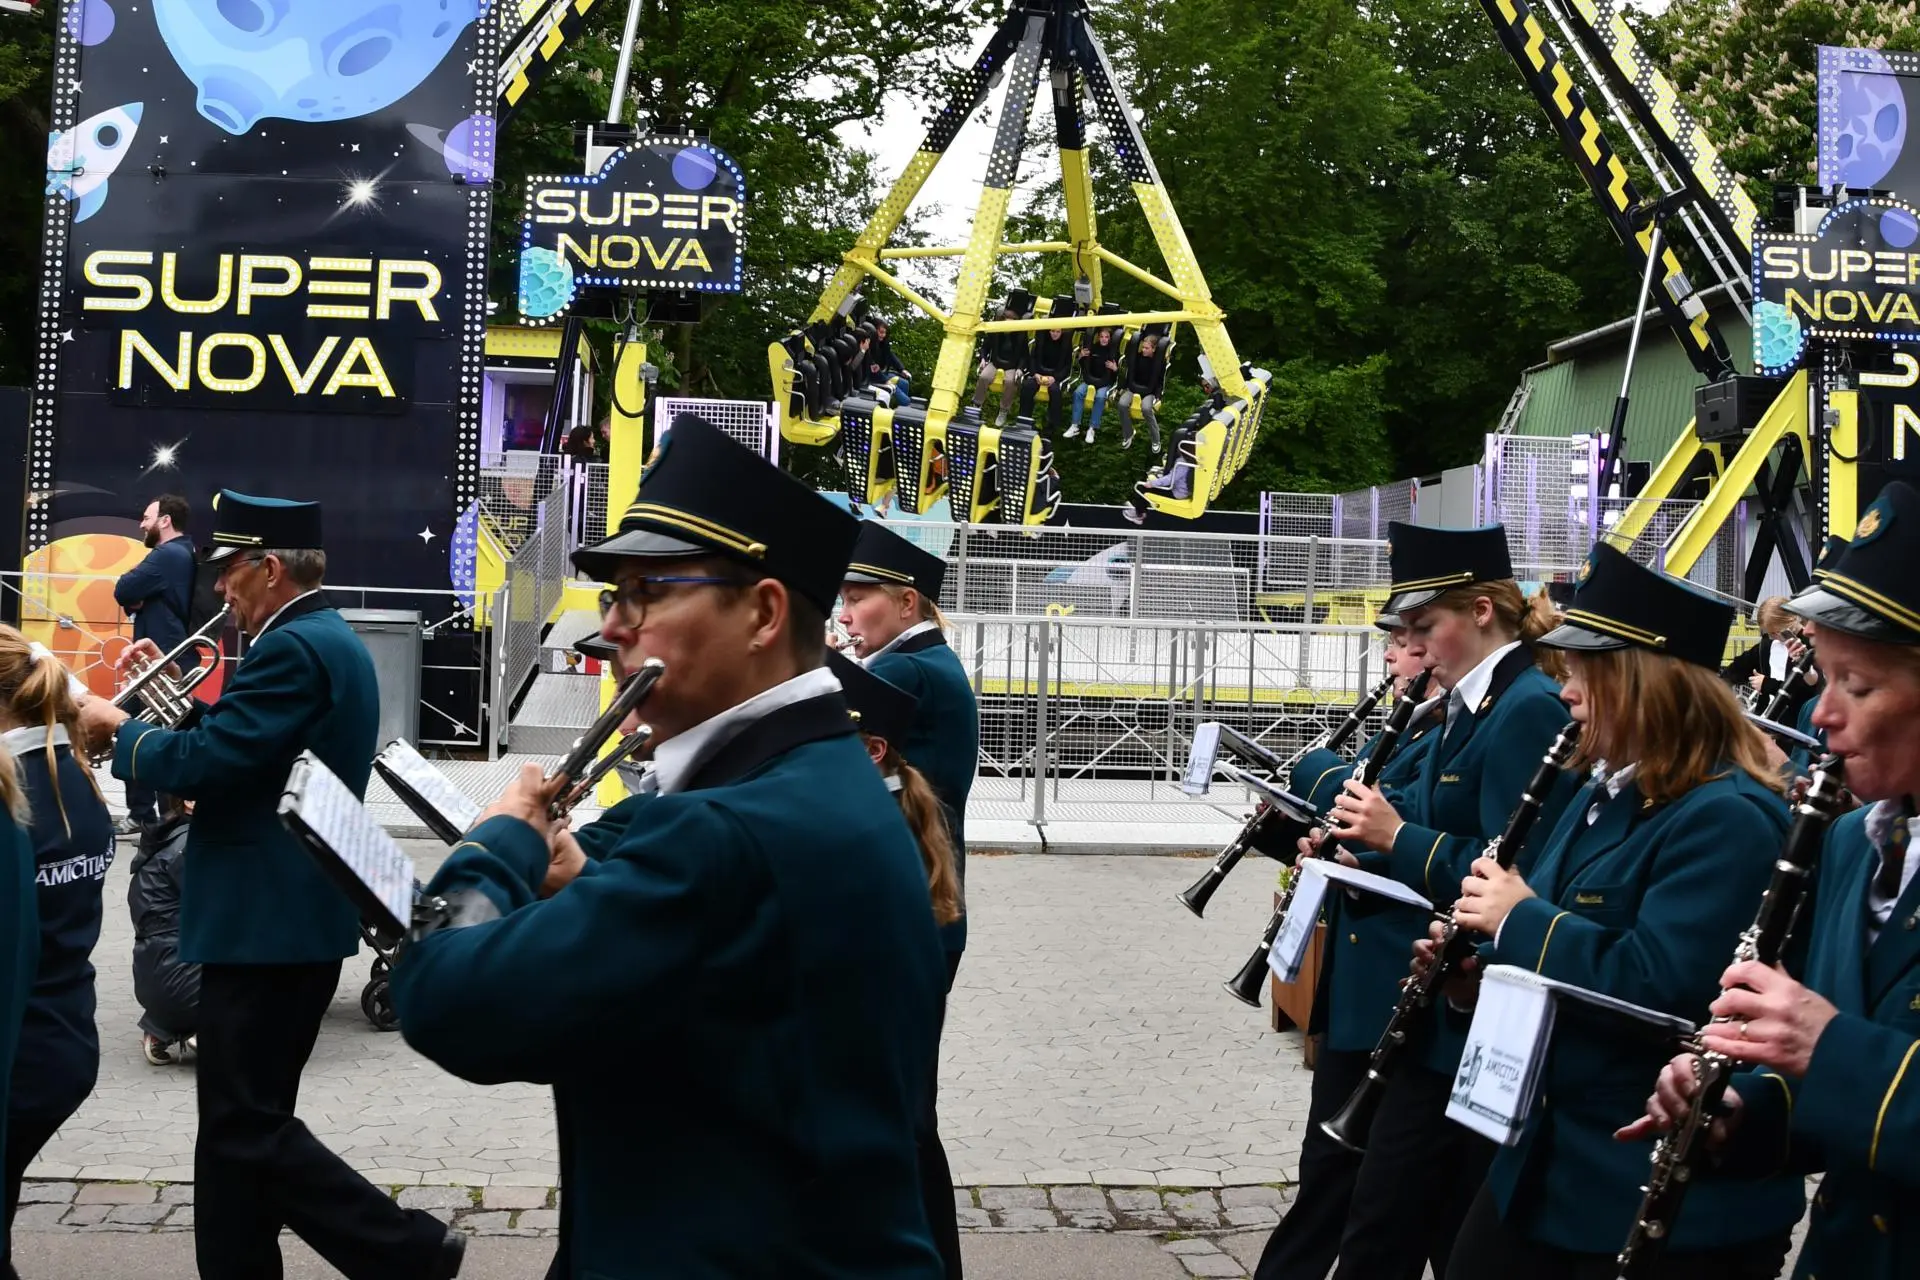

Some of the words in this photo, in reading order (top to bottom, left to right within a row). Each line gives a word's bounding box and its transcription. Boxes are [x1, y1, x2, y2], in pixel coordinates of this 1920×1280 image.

[535, 188, 738, 234] SUPER
[557, 232, 713, 272] NOVA
[83, 250, 442, 321] SUPER
[1785, 287, 1920, 324] NOVA
[119, 330, 396, 397] NOVA
[35, 854, 105, 886] AMICITIA
